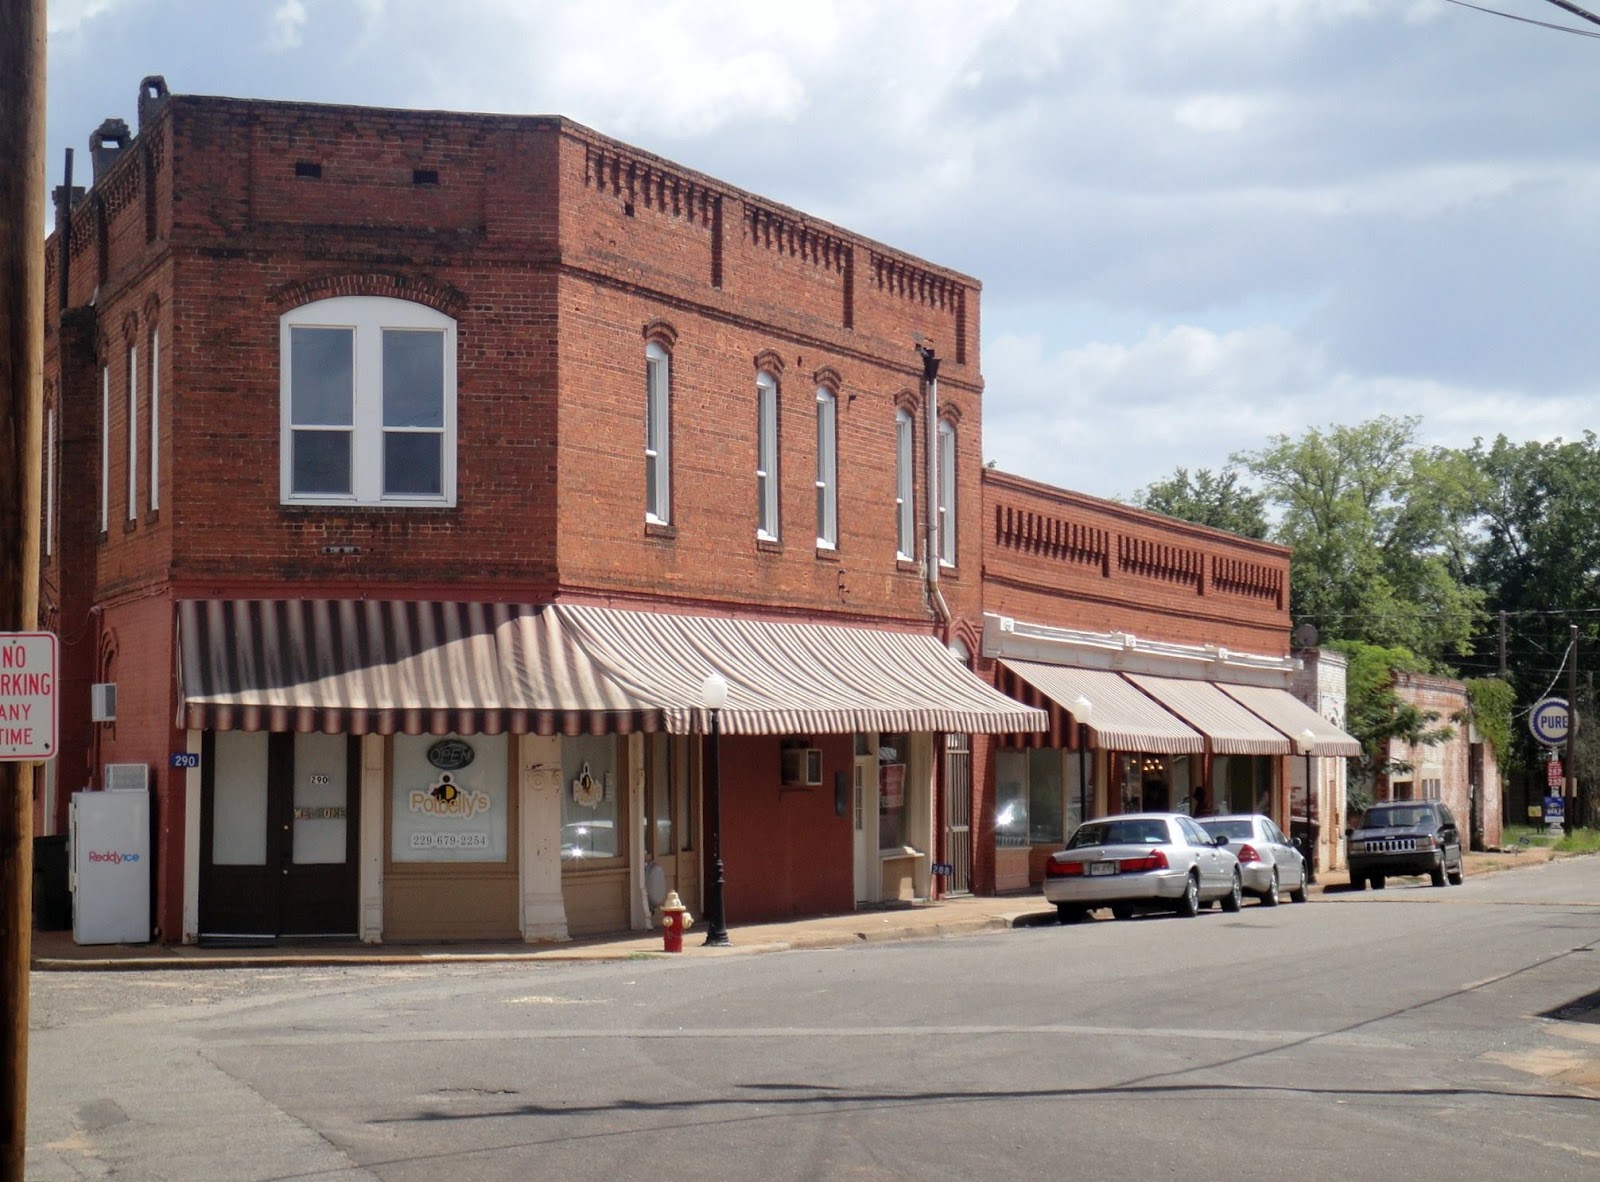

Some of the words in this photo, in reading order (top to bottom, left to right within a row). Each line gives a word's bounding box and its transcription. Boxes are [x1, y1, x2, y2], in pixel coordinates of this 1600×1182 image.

[2, 645, 26, 669] NO
[0, 704, 32, 721] ANY
[1541, 715, 1569, 729] PURE
[174, 755, 196, 767] 290
[311, 776, 328, 784] 290
[411, 793, 488, 818] Potbelly's
[413, 835, 486, 846] 229-679-2254
